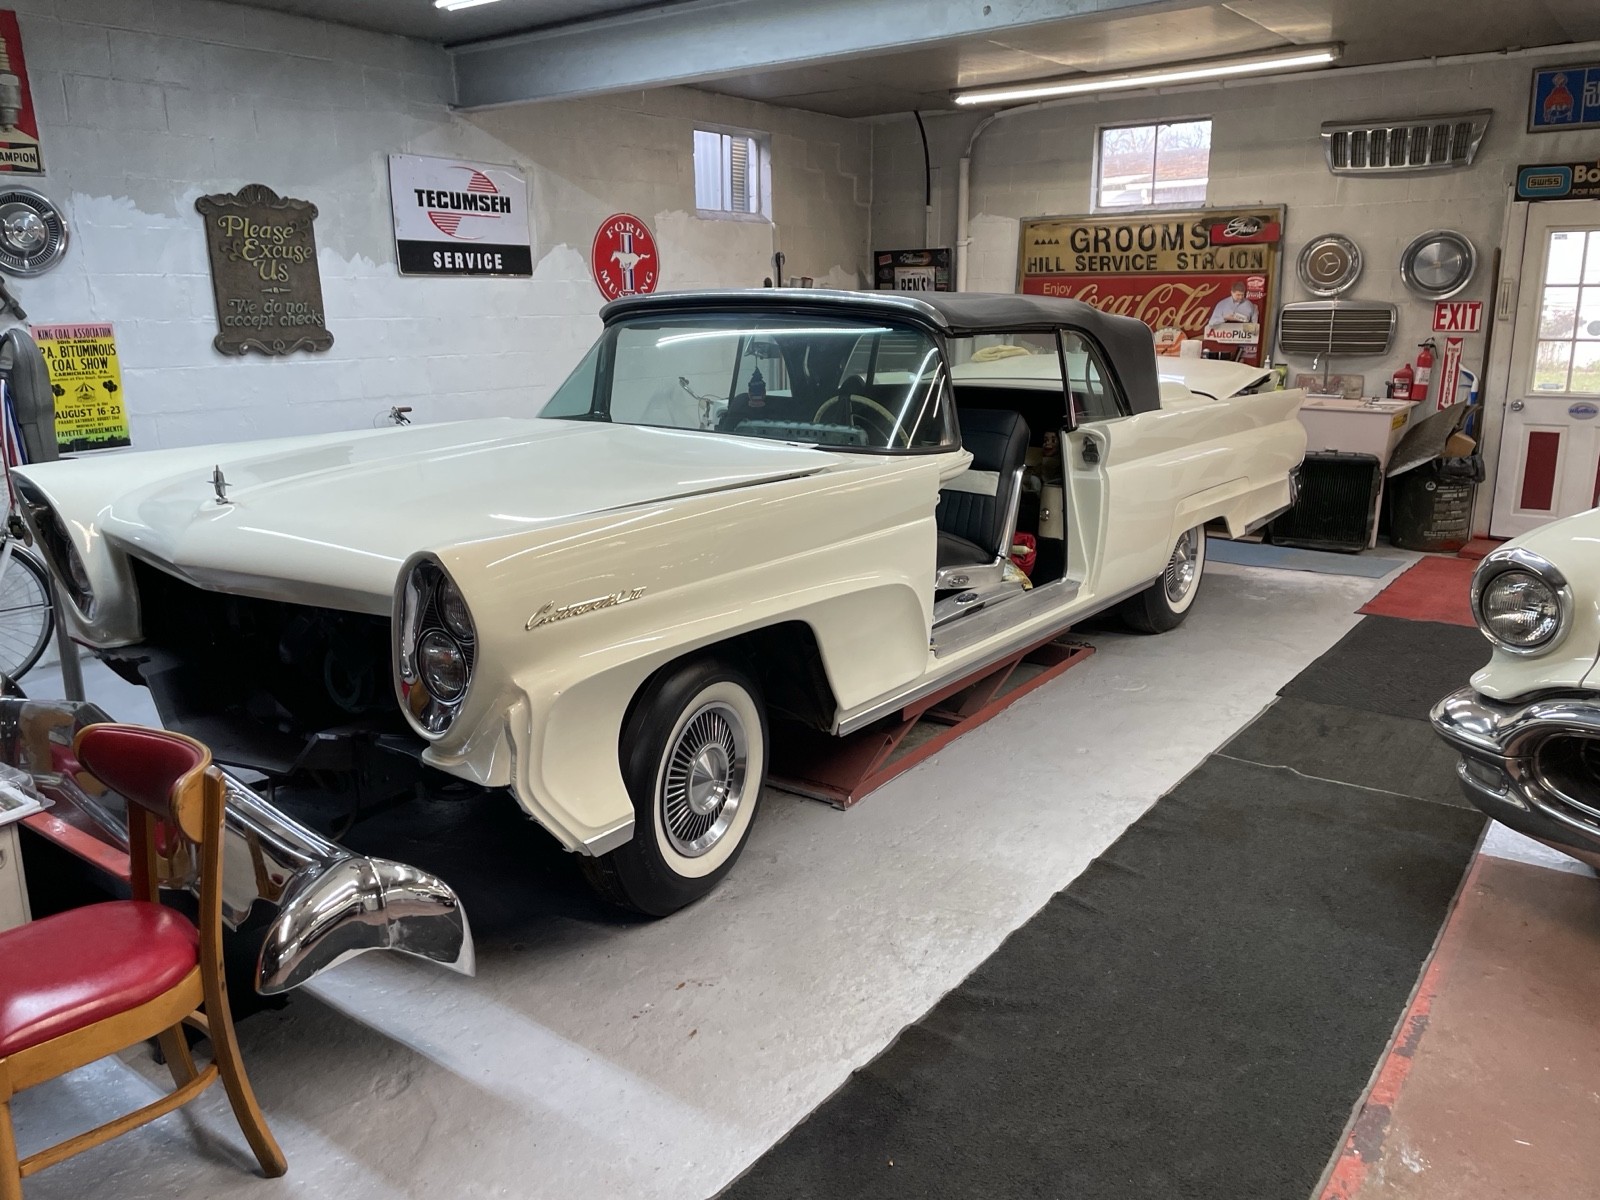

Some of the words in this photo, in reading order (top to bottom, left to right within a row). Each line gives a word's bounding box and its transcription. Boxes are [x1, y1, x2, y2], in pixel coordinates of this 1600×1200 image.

[0, 152, 36, 163] AMPION
[414, 188, 511, 214] TECUMSEH
[218, 214, 294, 244] Please
[606, 221, 645, 240] FORD
[1070, 223, 1209, 253] GROOMS
[242, 238, 312, 263] Excuse
[432, 251, 503, 270] SERVICE
[1027, 256, 1065, 273] HILL
[1075, 254, 1158, 271] SERVICE
[253, 259, 288, 282] Us
[1043, 283, 1072, 296] Enjoy
[228, 298, 257, 314] We
[264, 299, 282, 313] do
[224, 312, 275, 330] accept
[279, 309, 325, 328] checks
[1434, 303, 1480, 330] EXIT
[37, 330, 53, 340] KING
[55, 328, 71, 339] COAL
[74, 327, 112, 338] ASSOCIATION
[1207, 328, 1252, 339] AutoPlus
[60, 344, 116, 358] BITUMINOUS
[52, 359, 78, 372] COAL
[81, 357, 108, 370] SHOW
[54, 409, 93, 419] AUGUST
[85, 426, 123, 435] AMUSEMENTS
